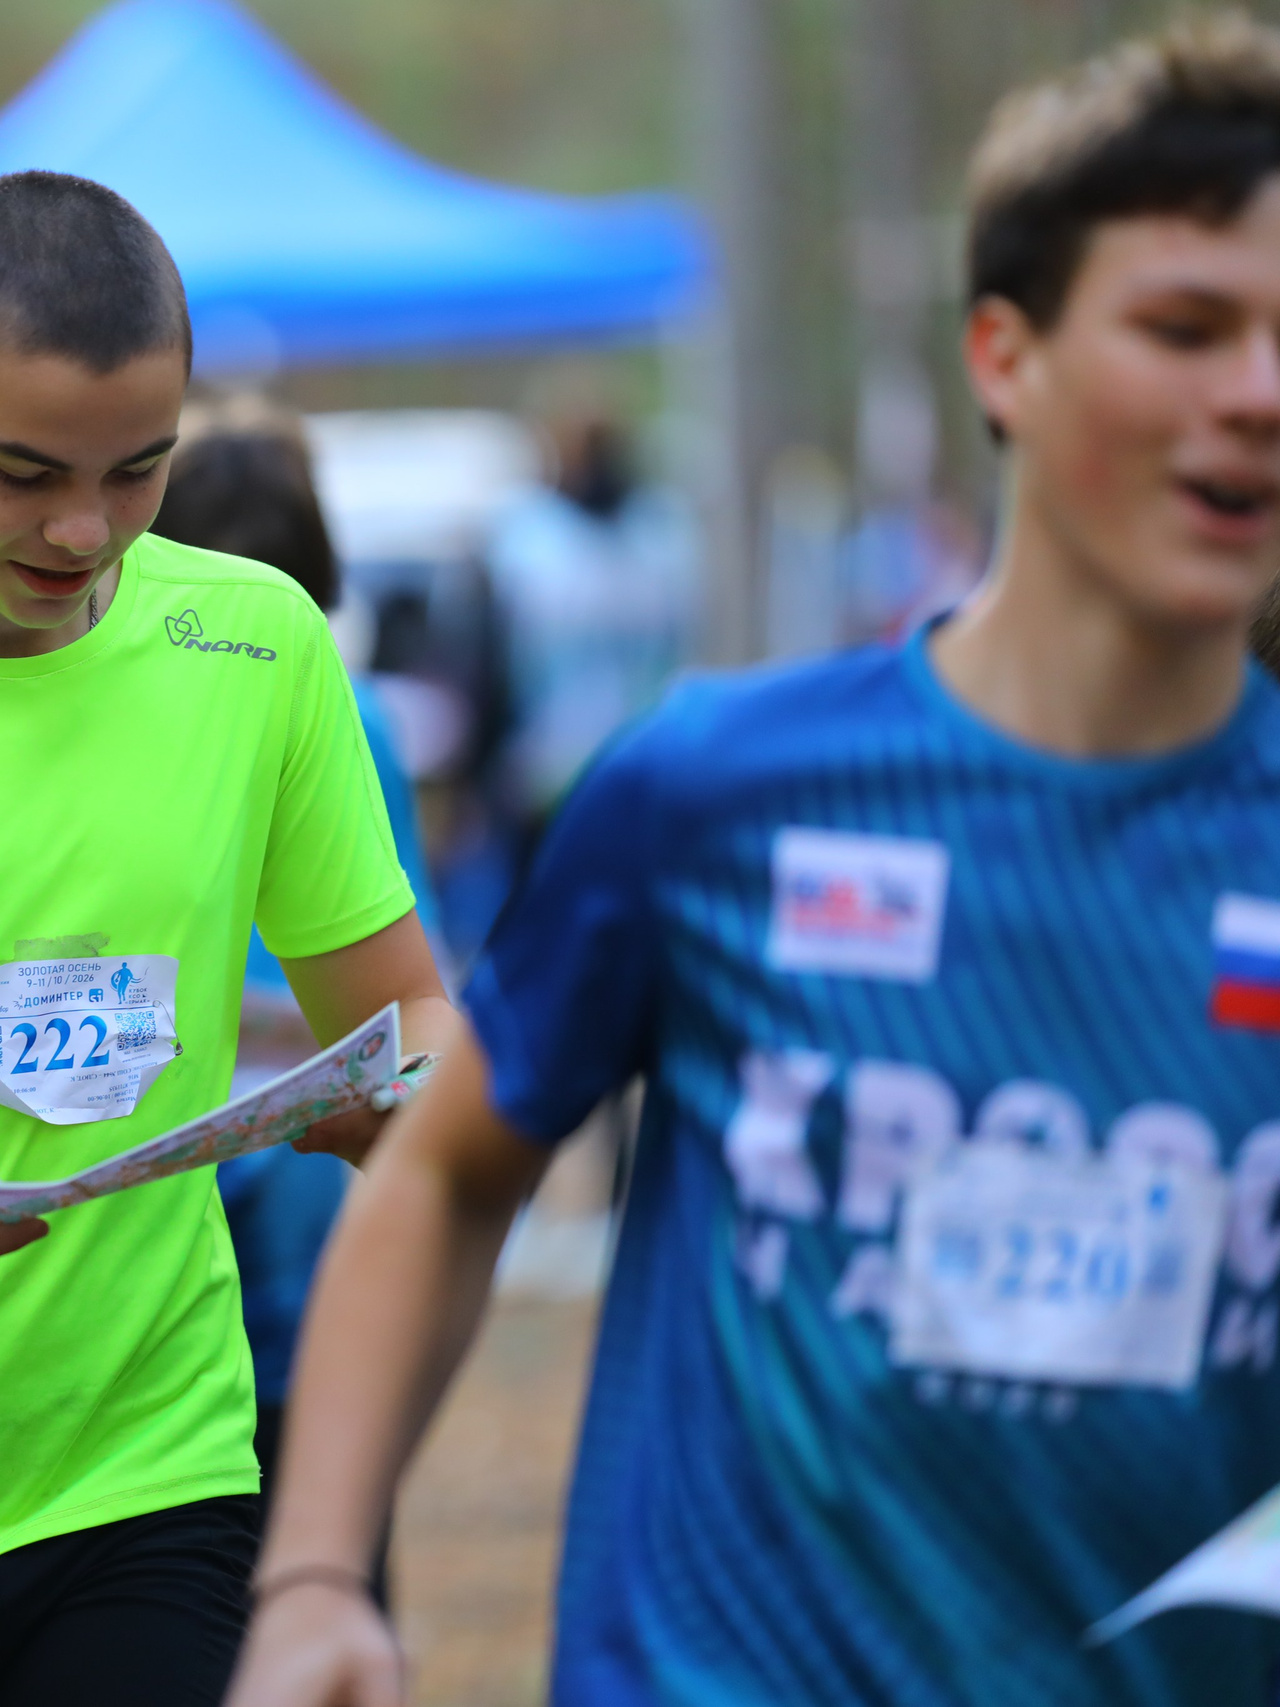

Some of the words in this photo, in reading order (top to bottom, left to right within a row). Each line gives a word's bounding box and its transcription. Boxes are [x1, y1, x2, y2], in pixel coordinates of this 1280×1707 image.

[184, 638, 277, 662] NORD
[18, 964, 65, 977] ЗОЛОТАЯ
[67, 962, 102, 973] ОСЕНЬ
[53, 975, 63, 985] 10
[72, 973, 95, 983] 2026
[23, 991, 83, 1009] ДОМИНТЕР
[9, 1015, 110, 1075] 222
[992, 1222, 1131, 1304] 220
